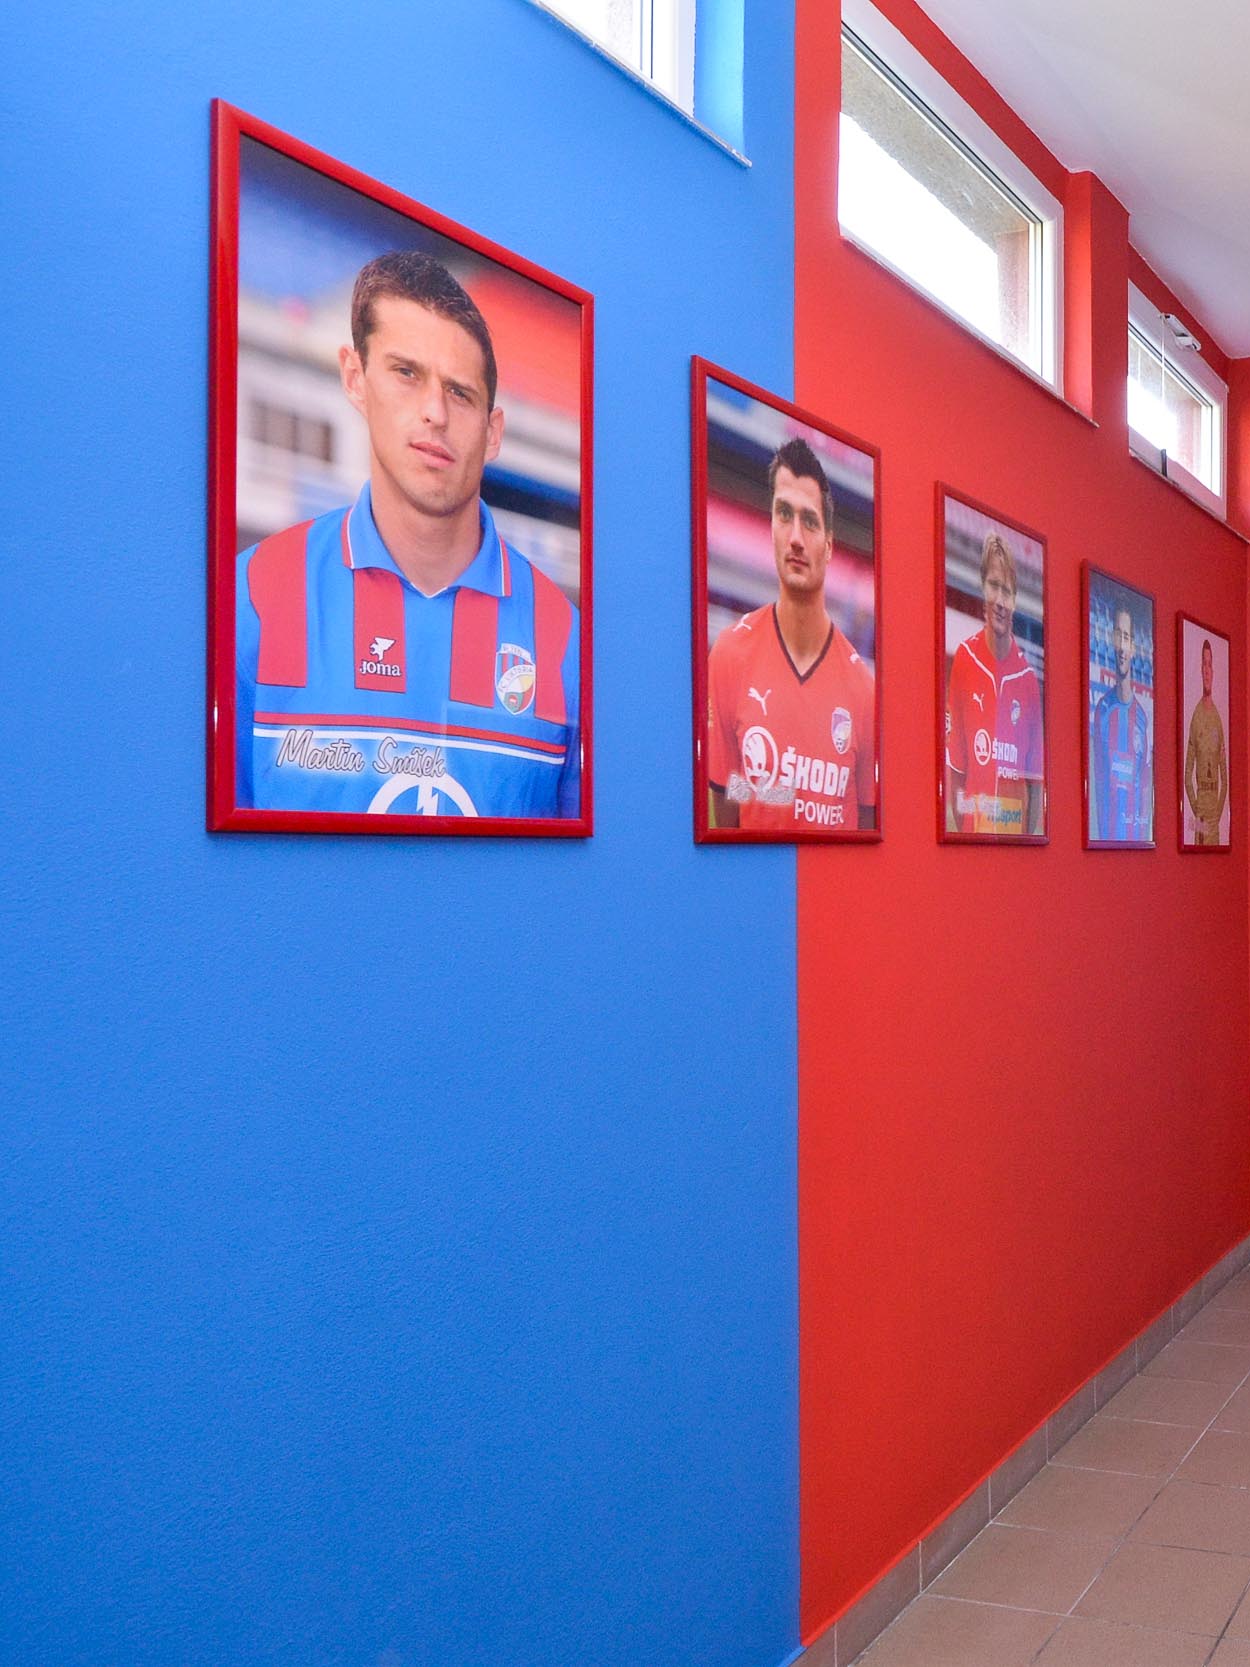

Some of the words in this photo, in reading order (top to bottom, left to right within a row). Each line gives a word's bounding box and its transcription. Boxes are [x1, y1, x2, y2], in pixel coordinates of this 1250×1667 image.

[276, 729, 365, 773] Martin
[779, 745, 850, 799] ŠKODA
[794, 798, 845, 826] POWER
